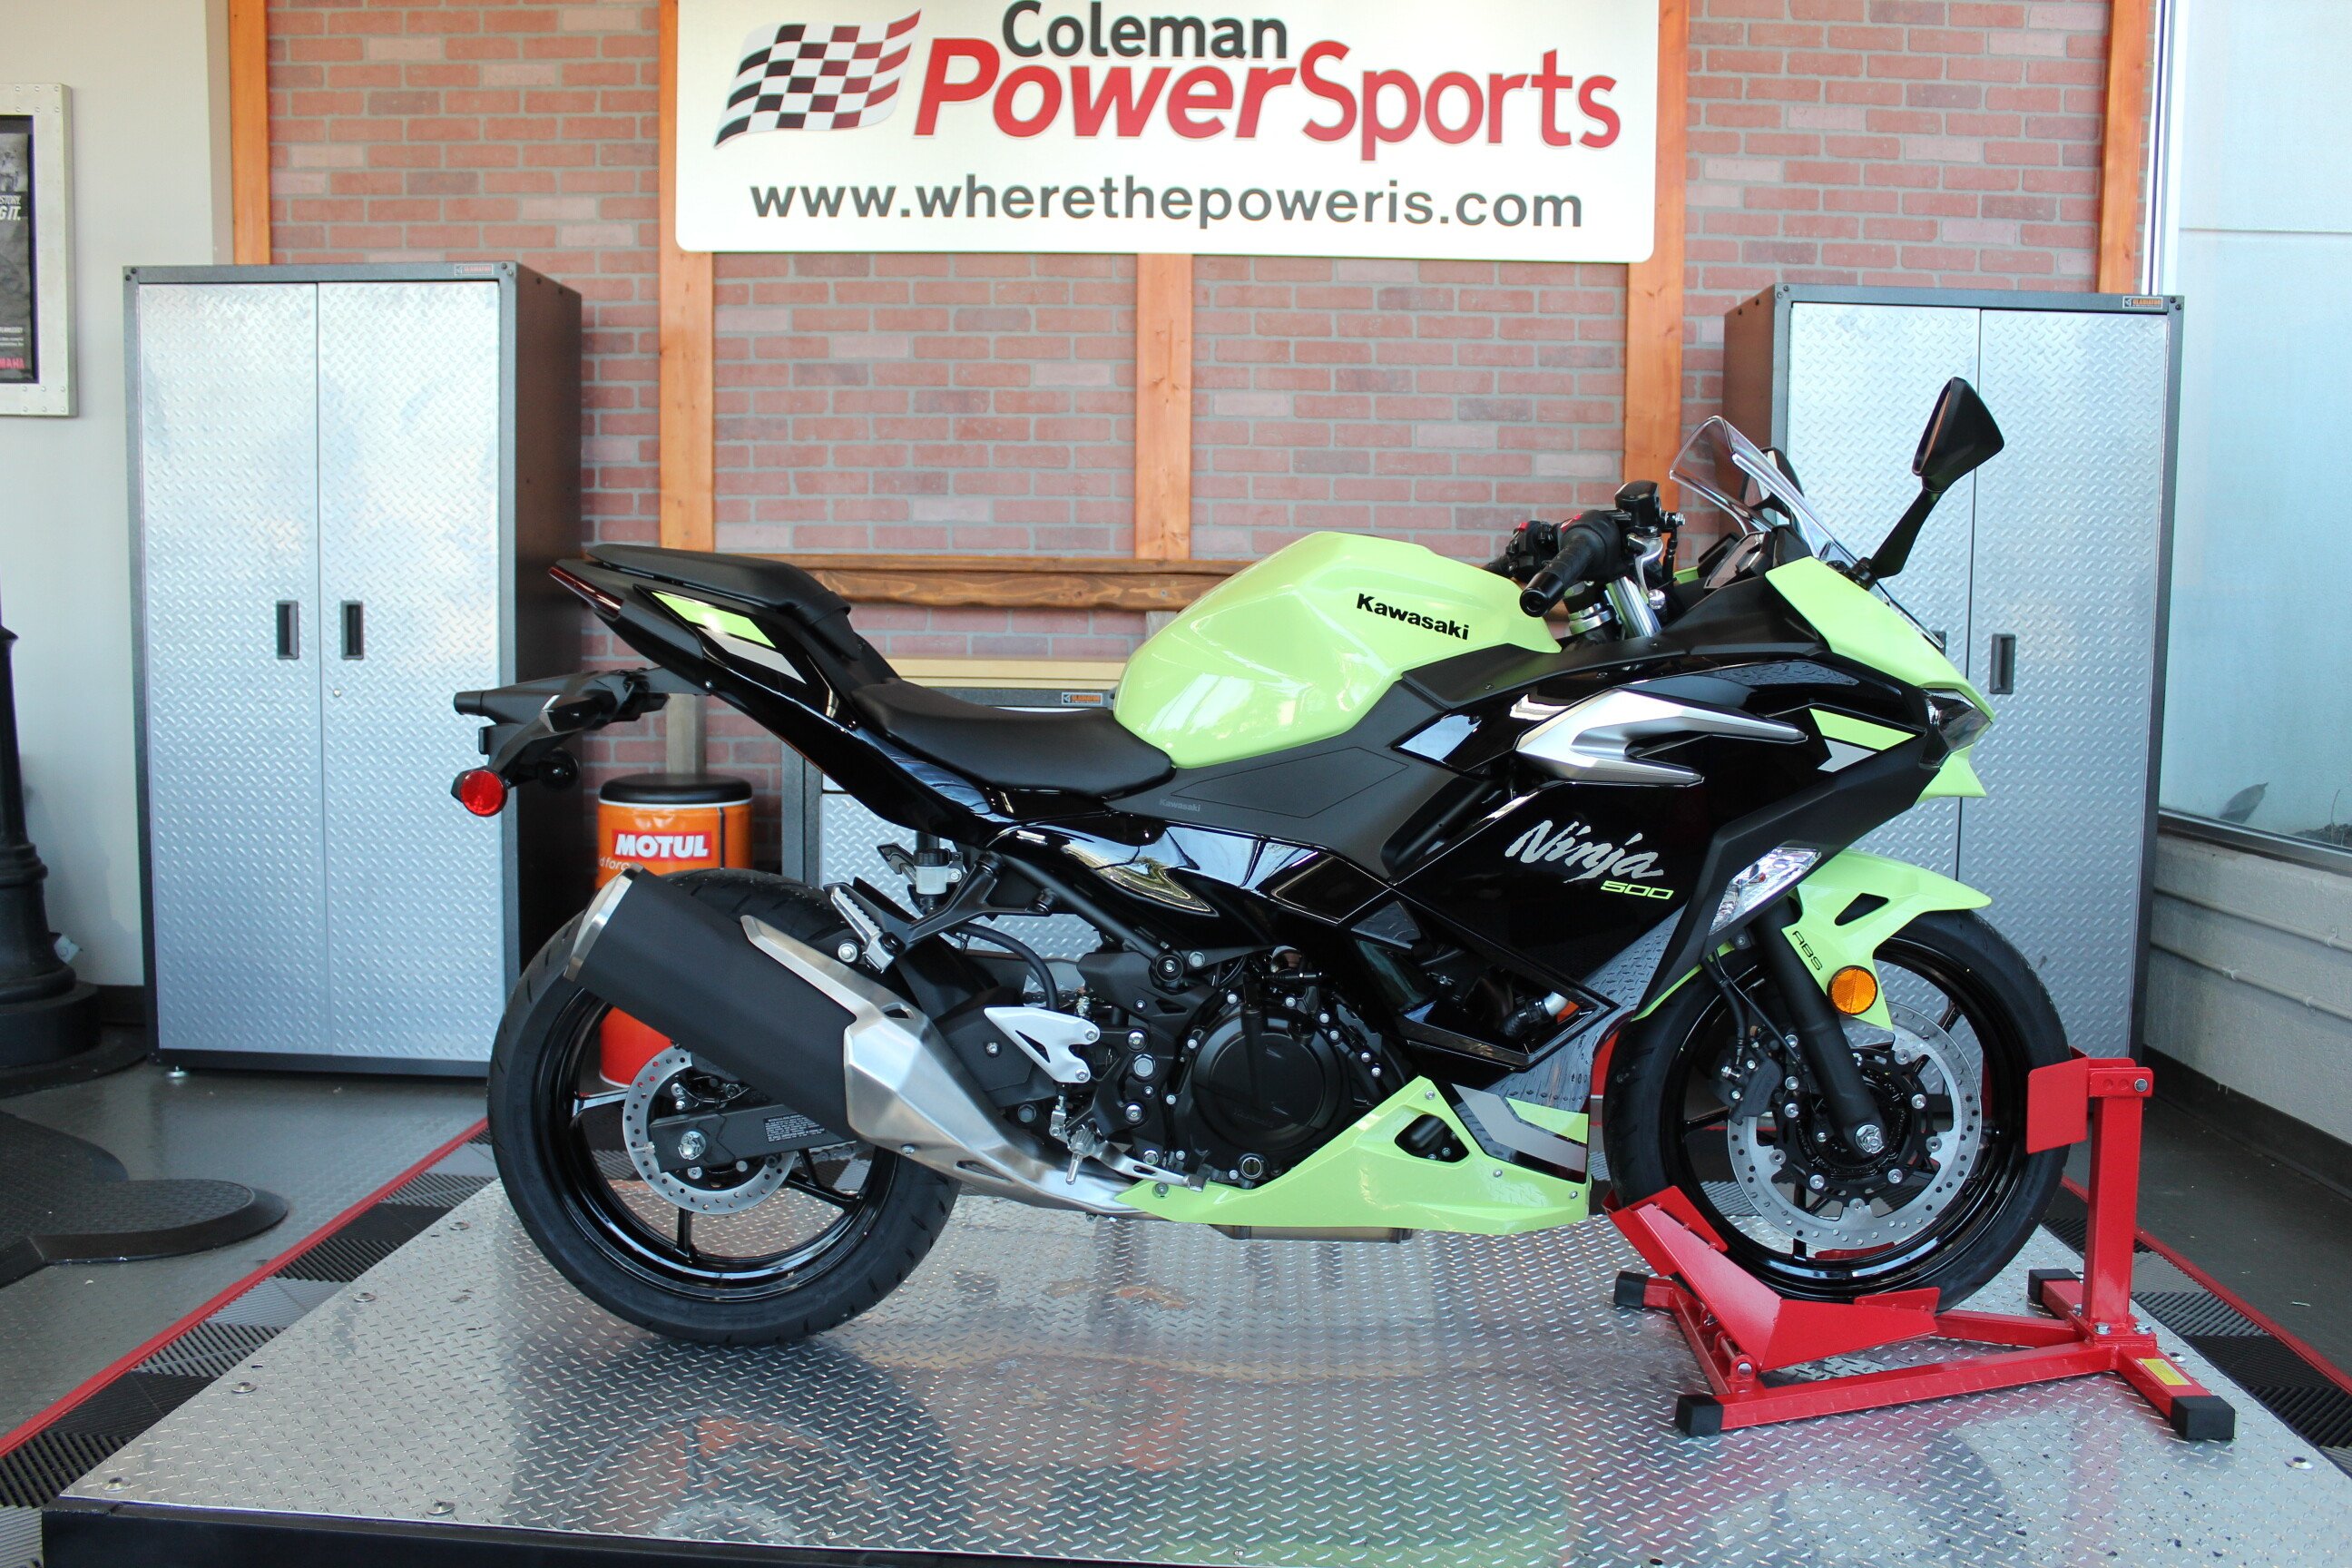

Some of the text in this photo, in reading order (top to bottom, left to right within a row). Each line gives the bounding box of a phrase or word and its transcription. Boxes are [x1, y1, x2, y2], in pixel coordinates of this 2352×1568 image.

[1002, 0, 1287, 58] Coleman
[913, 37, 1621, 162] PowerSports
[750, 174, 1583, 230] www.wherethepoweris.com
[1357, 593, 1469, 641] Kawasaki
[614, 833, 709, 858] MOTUL
[1504, 819, 1664, 884] Ninja
[1600, 880, 1674, 900] 500
[1792, 930, 1823, 971] ABS
